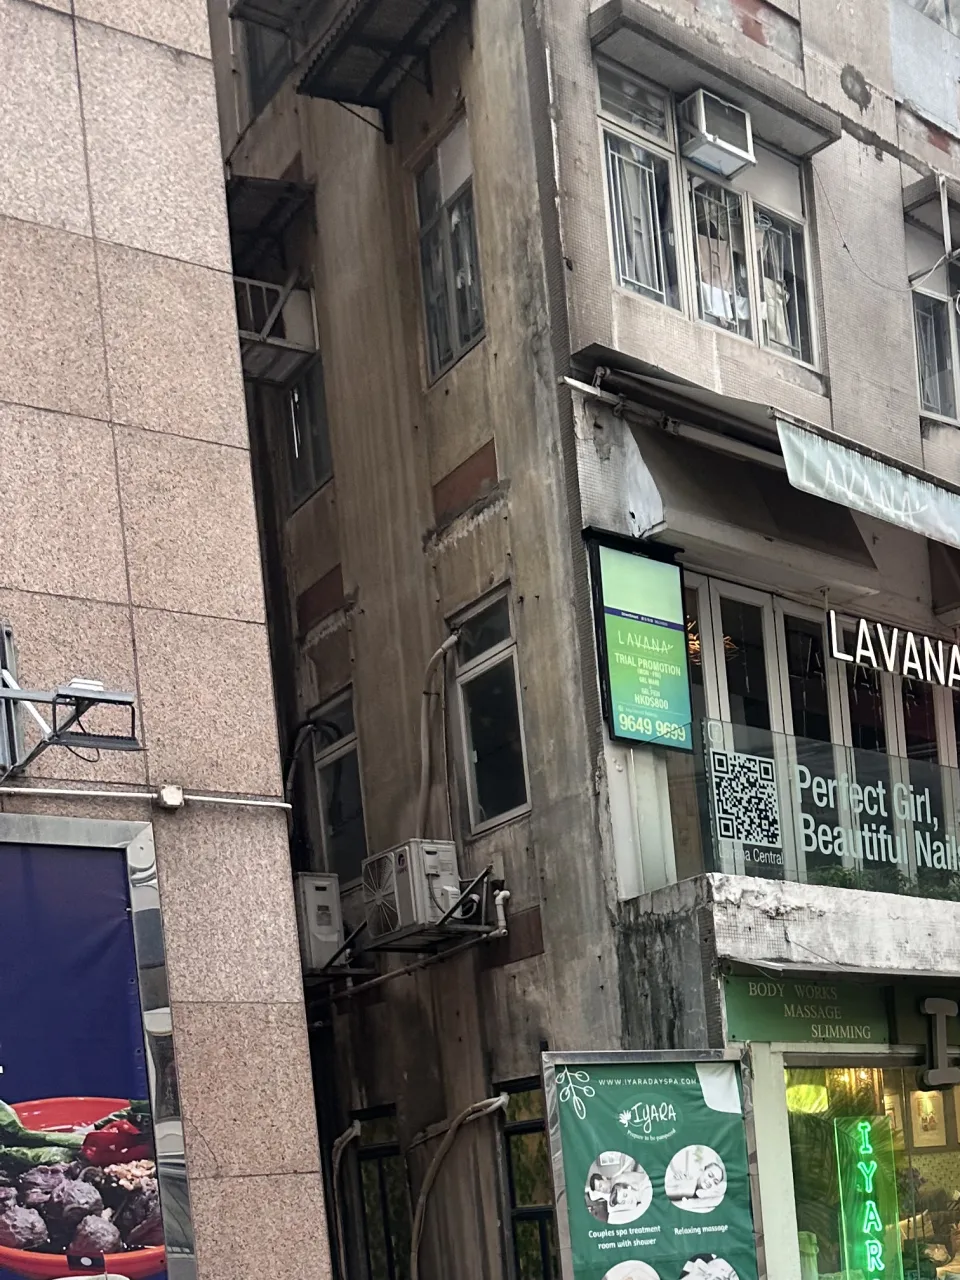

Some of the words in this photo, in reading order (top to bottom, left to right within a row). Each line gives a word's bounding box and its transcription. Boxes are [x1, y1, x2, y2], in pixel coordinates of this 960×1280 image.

[618, 630, 669, 654] LAVANA
[614, 652, 637, 667] TRIAL
[638, 657, 681, 676] PROMOTION
[634, 694, 669, 710] HKD$800
[619, 713, 653, 735] 9649
[655, 719, 686, 741] 9699
[794, 764, 888, 818] Perfect
[893, 783, 939, 832] Girl,
[799, 812, 909, 865] Beautiful
[753, 848, 784, 865] Central
[749, 982, 785, 997] BODY
[794, 984, 838, 1000] WORKS
[784, 1004, 842, 1019] MASSAGE
[811, 1024, 871, 1039] SLIMMING
[598, 1078, 697, 1086] WWW.IYARADAYSPA.COM
[588, 1230, 615, 1239] Couples
[616, 1228, 628, 1238] spa
[629, 1225, 661, 1235] treatment
[674, 1226, 701, 1236] Relaxing
[702, 1225, 729, 1233] massage
[598, 1242, 616, 1250] room
[617, 1240, 632, 1248] with
[633, 1238, 656, 1247] shower
